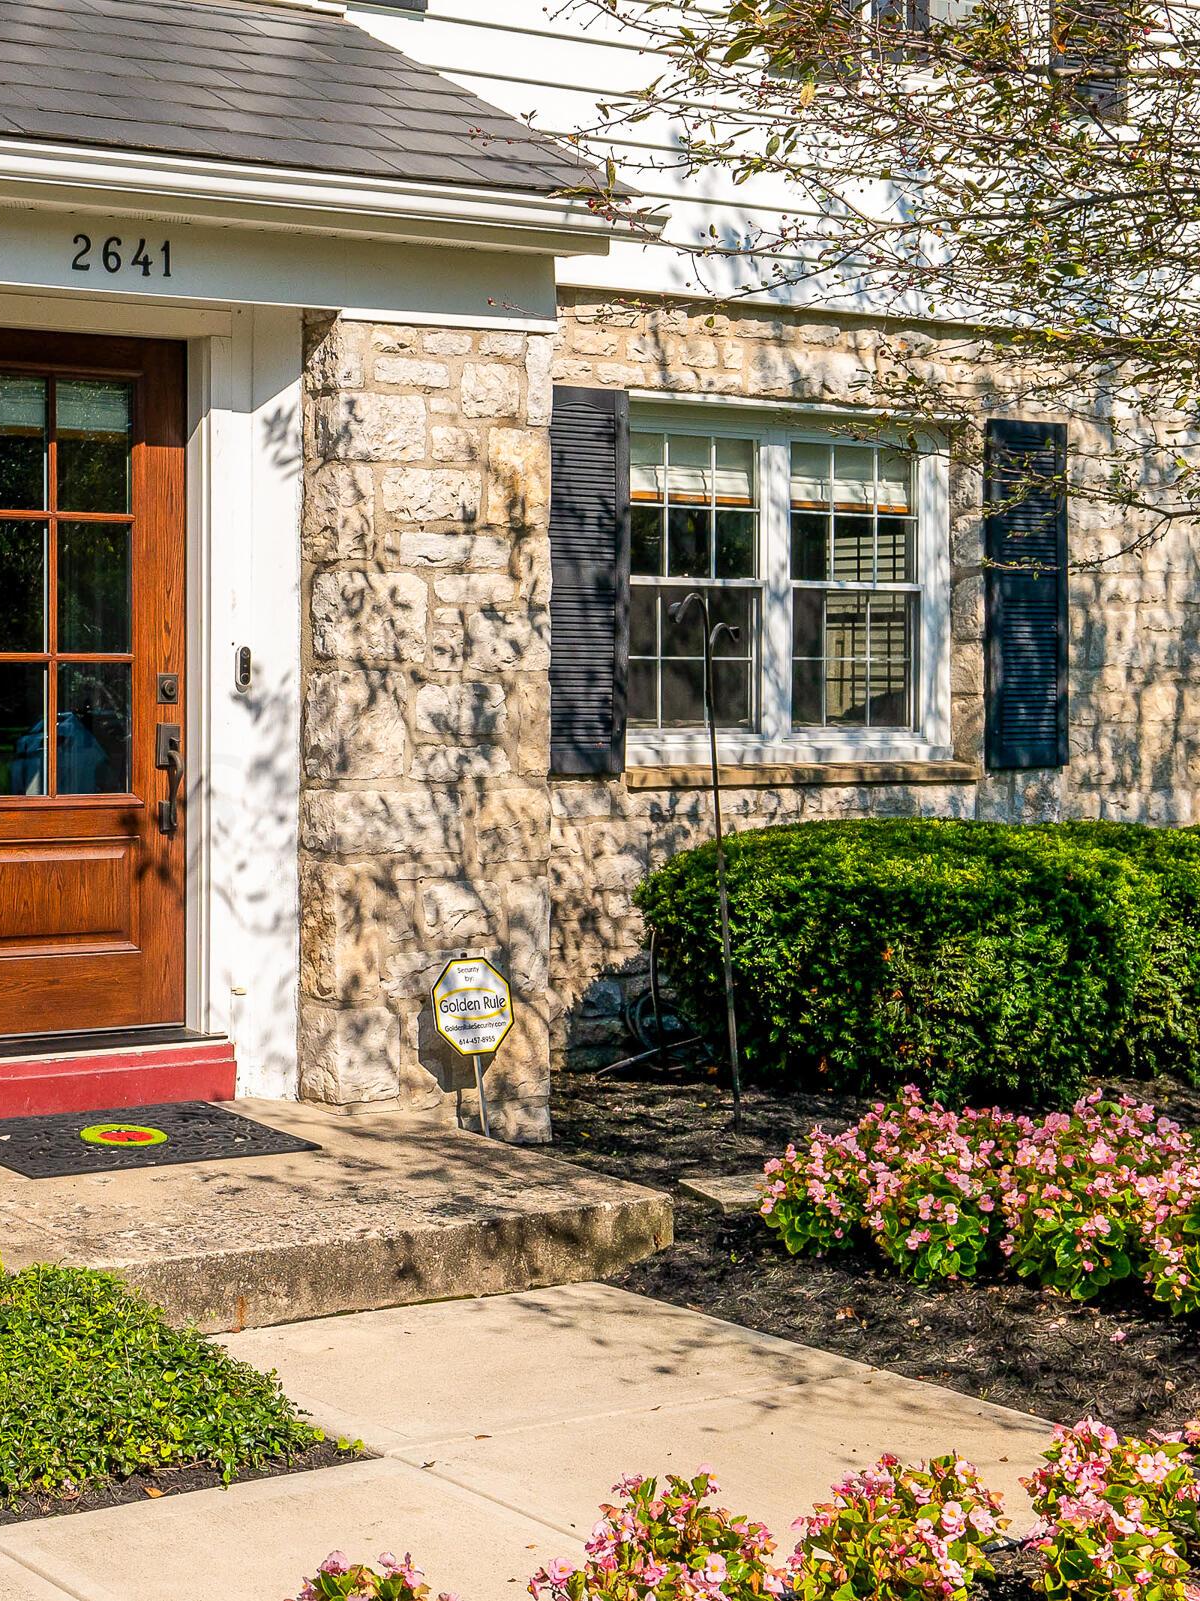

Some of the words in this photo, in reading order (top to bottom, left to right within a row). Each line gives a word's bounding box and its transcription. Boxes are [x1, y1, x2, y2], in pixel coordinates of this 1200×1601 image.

[71, 233, 172, 277] 2641
[457, 966, 480, 975] Security
[439, 997, 481, 1014] Golden
[483, 995, 506, 1010] Rule
